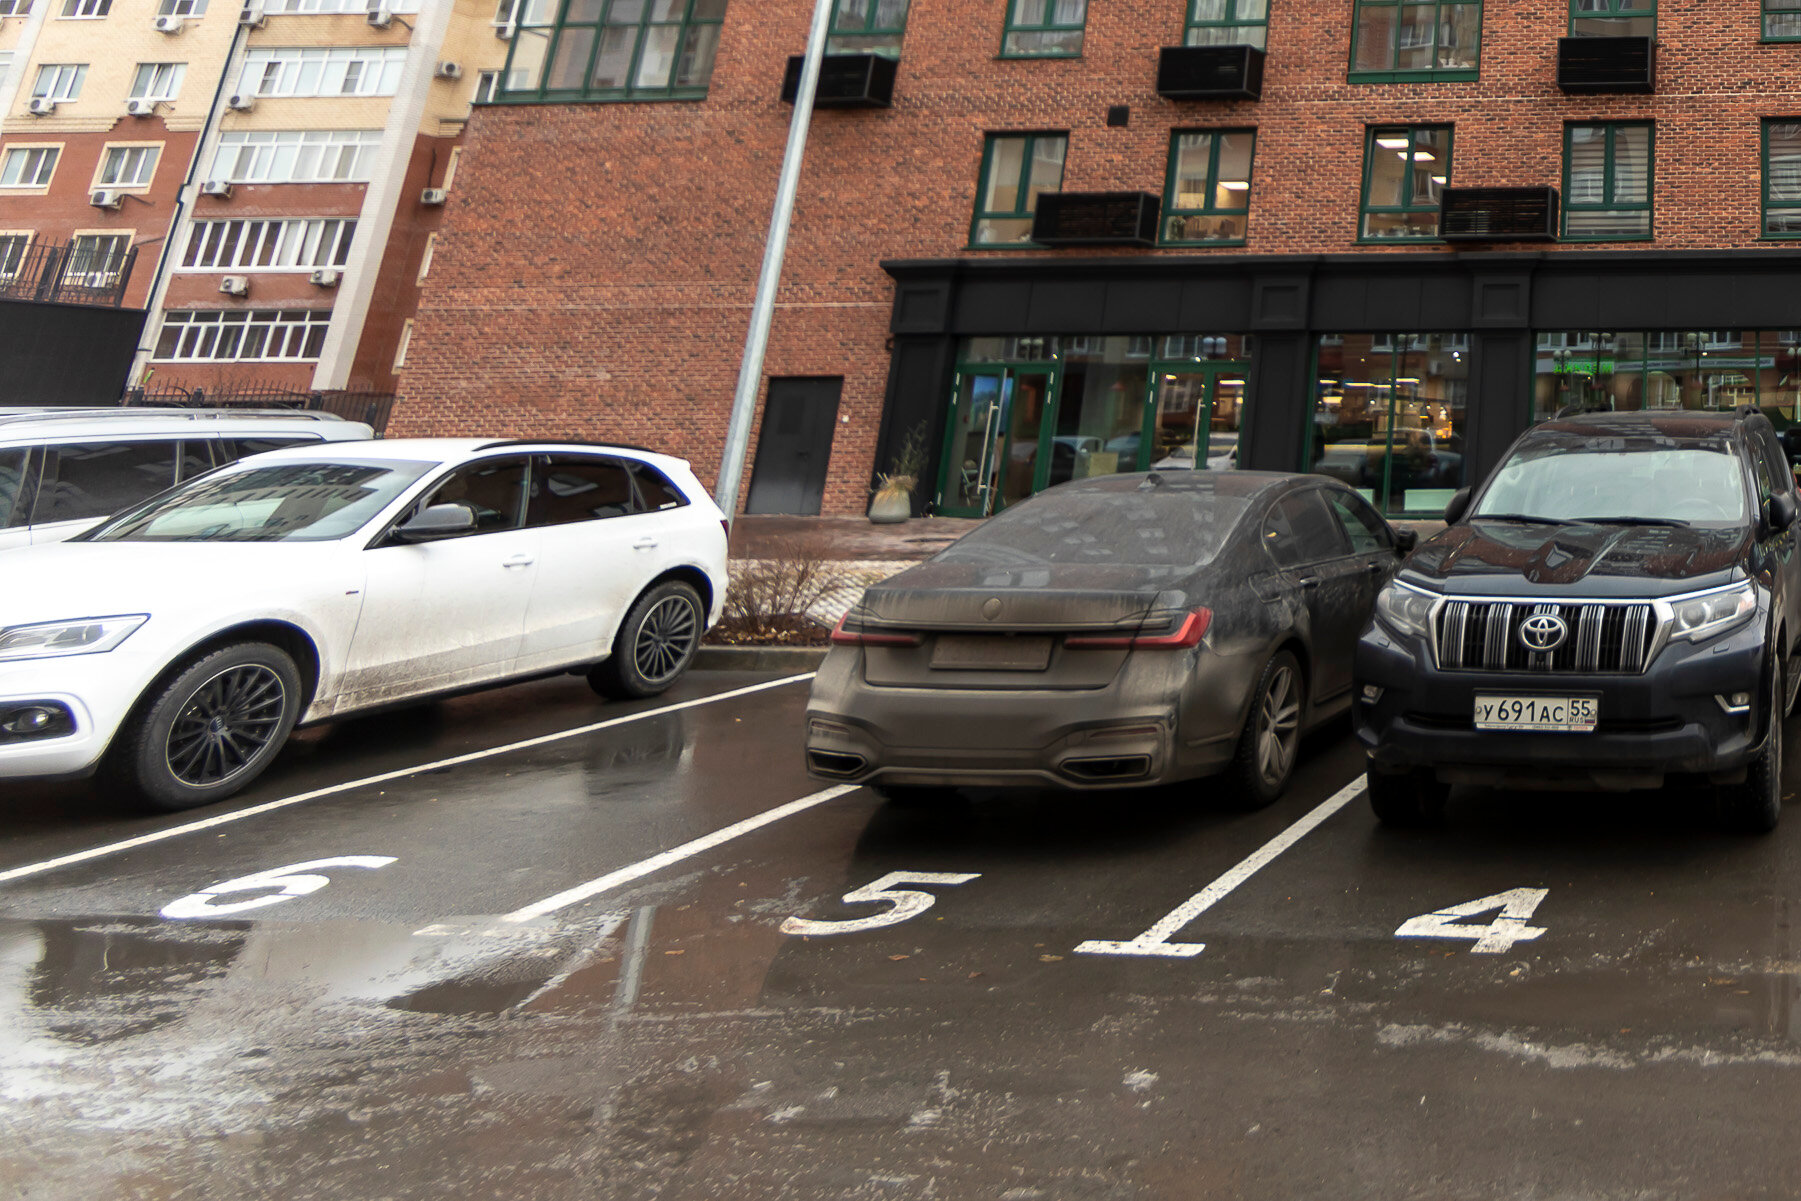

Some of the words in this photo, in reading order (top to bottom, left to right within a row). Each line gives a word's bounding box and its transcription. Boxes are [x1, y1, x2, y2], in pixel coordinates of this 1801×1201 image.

[1570, 700, 1591, 717] 55
[160, 855, 399, 919] 6
[780, 872, 982, 936] 5
[1395, 887, 1549, 954] 4
